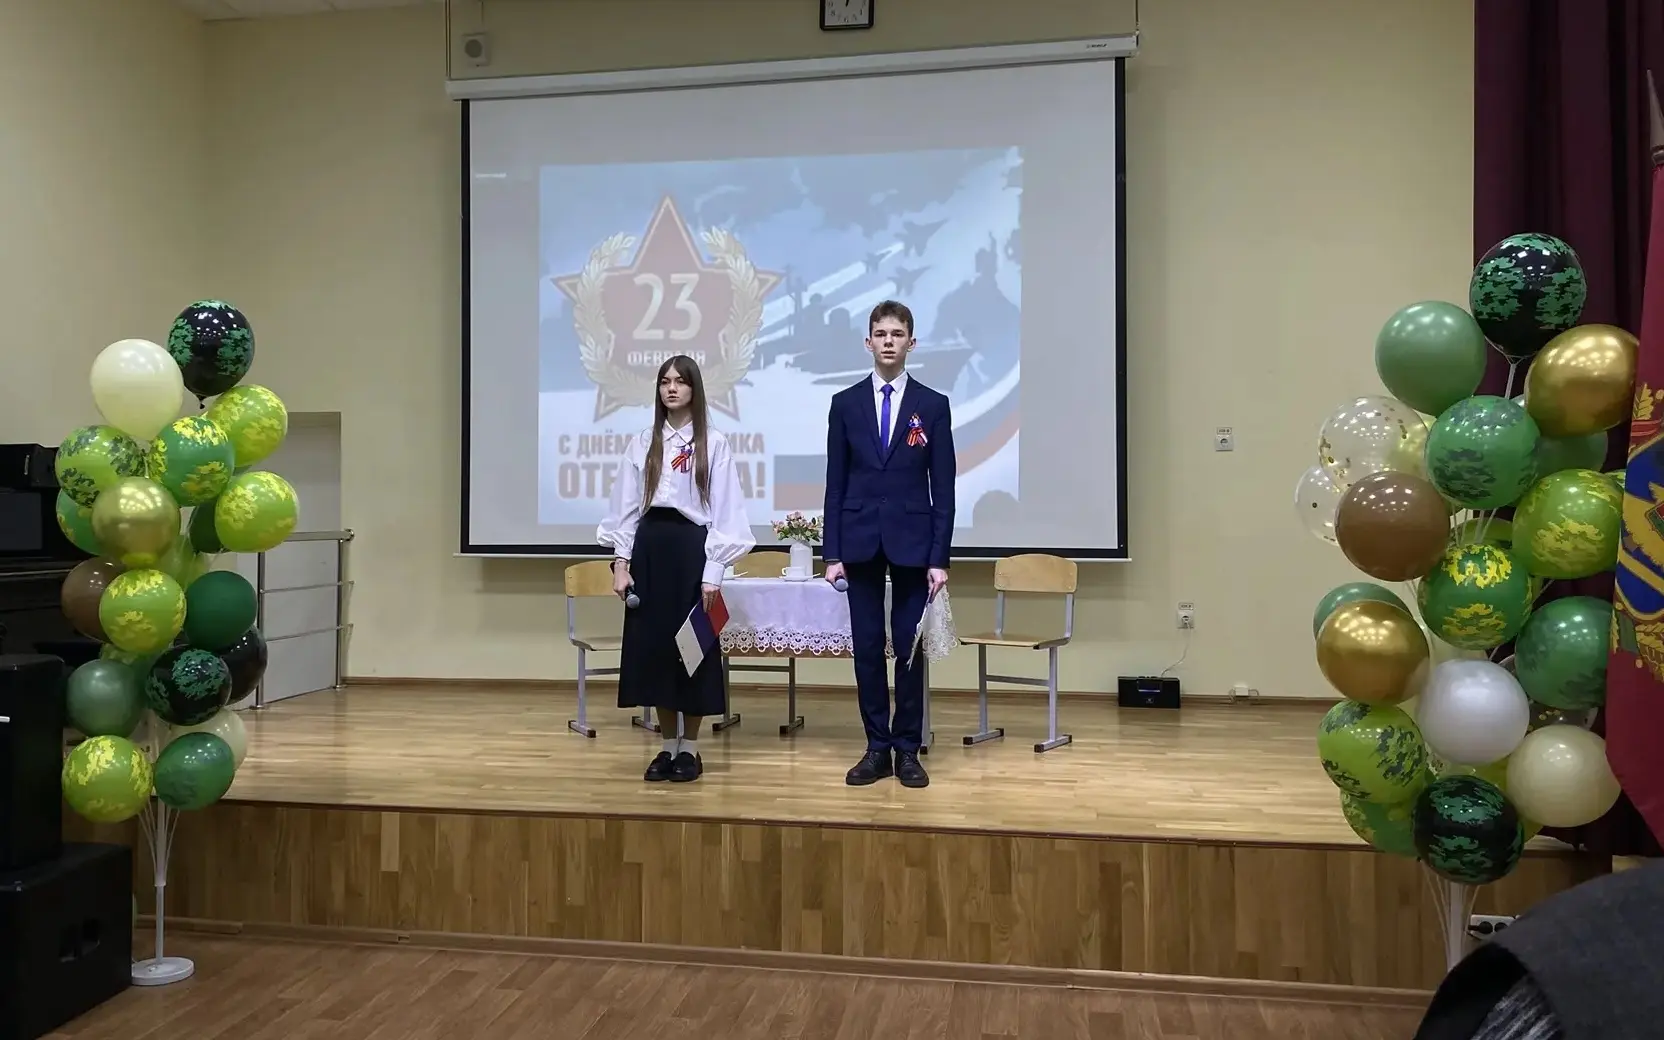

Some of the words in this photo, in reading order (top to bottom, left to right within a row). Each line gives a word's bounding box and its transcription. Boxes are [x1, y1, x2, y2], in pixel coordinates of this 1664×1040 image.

[632, 272, 702, 341] 23
[627, 350, 706, 366] ФЕВРЯ
[558, 434, 571, 455] С
